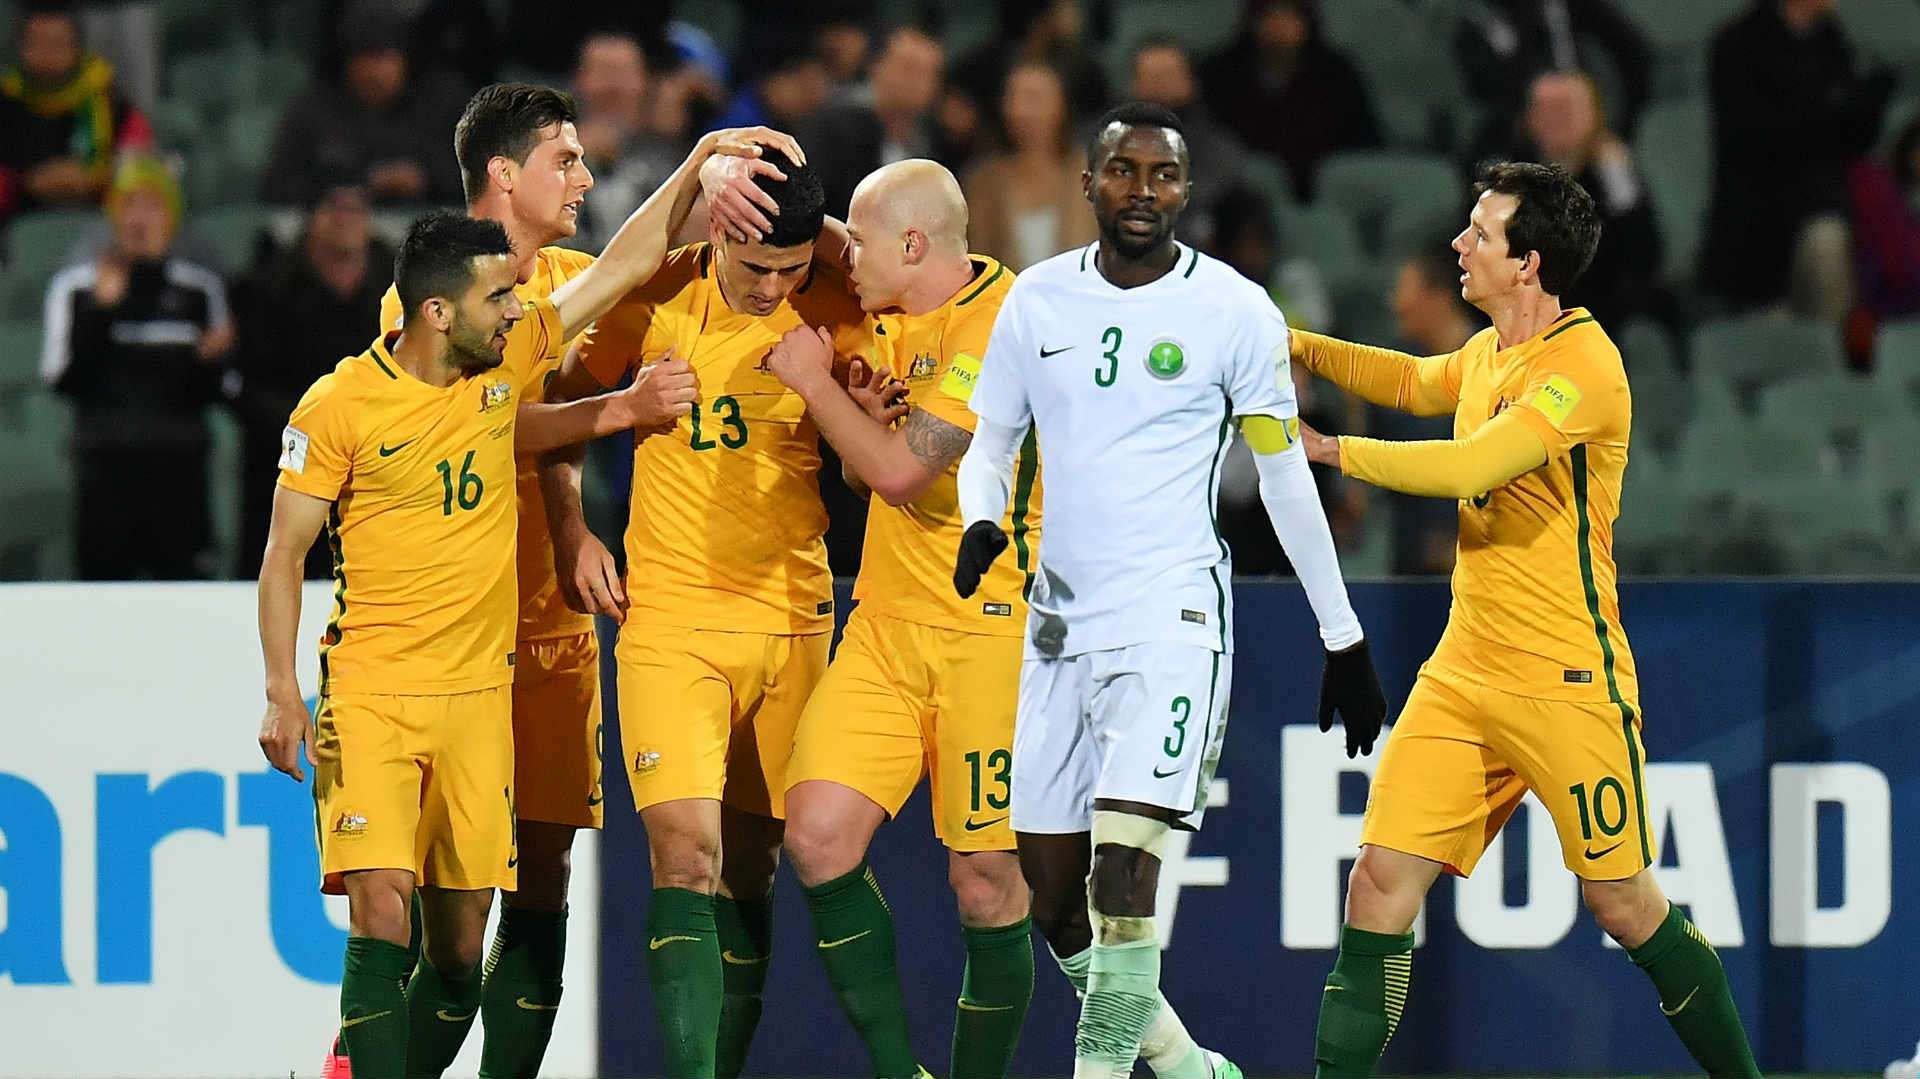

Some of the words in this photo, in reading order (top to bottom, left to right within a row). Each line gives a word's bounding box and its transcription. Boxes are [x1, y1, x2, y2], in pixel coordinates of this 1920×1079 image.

[951, 366, 972, 382] FIFA
[1094, 326, 1122, 388] 3
[1544, 384, 1565, 402] FIFA
[436, 450, 484, 516] 16
[1163, 695, 1192, 759] 3
[965, 748, 1012, 812] 13
[1569, 776, 1627, 840] 10
